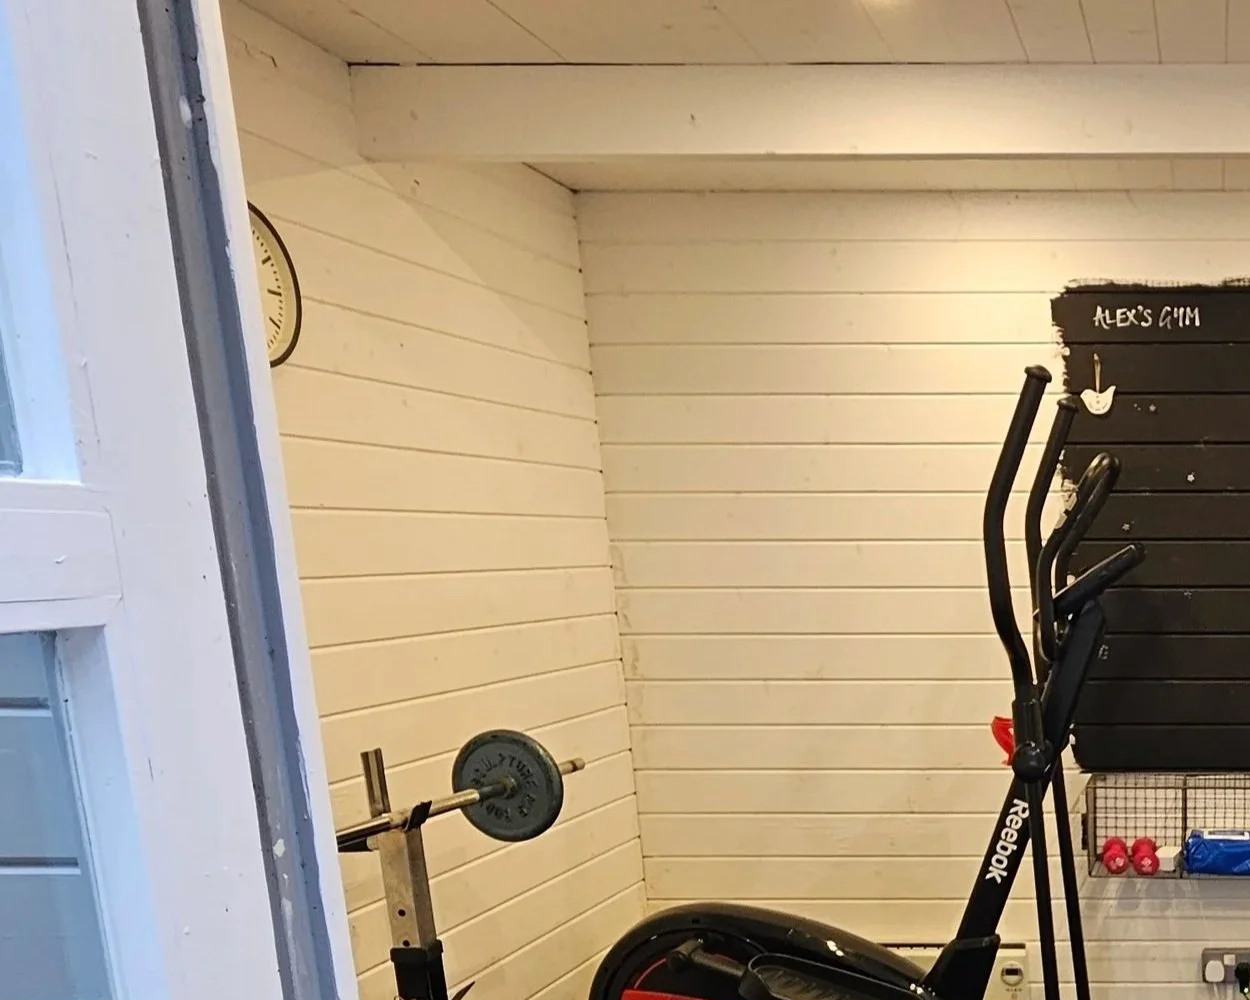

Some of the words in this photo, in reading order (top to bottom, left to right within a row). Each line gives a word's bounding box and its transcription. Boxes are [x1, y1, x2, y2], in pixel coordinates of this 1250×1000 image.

[1092, 304, 1153, 330] ALEX'S
[1158, 305, 1201, 330] GYM
[985, 798, 1030, 884] Reebok
